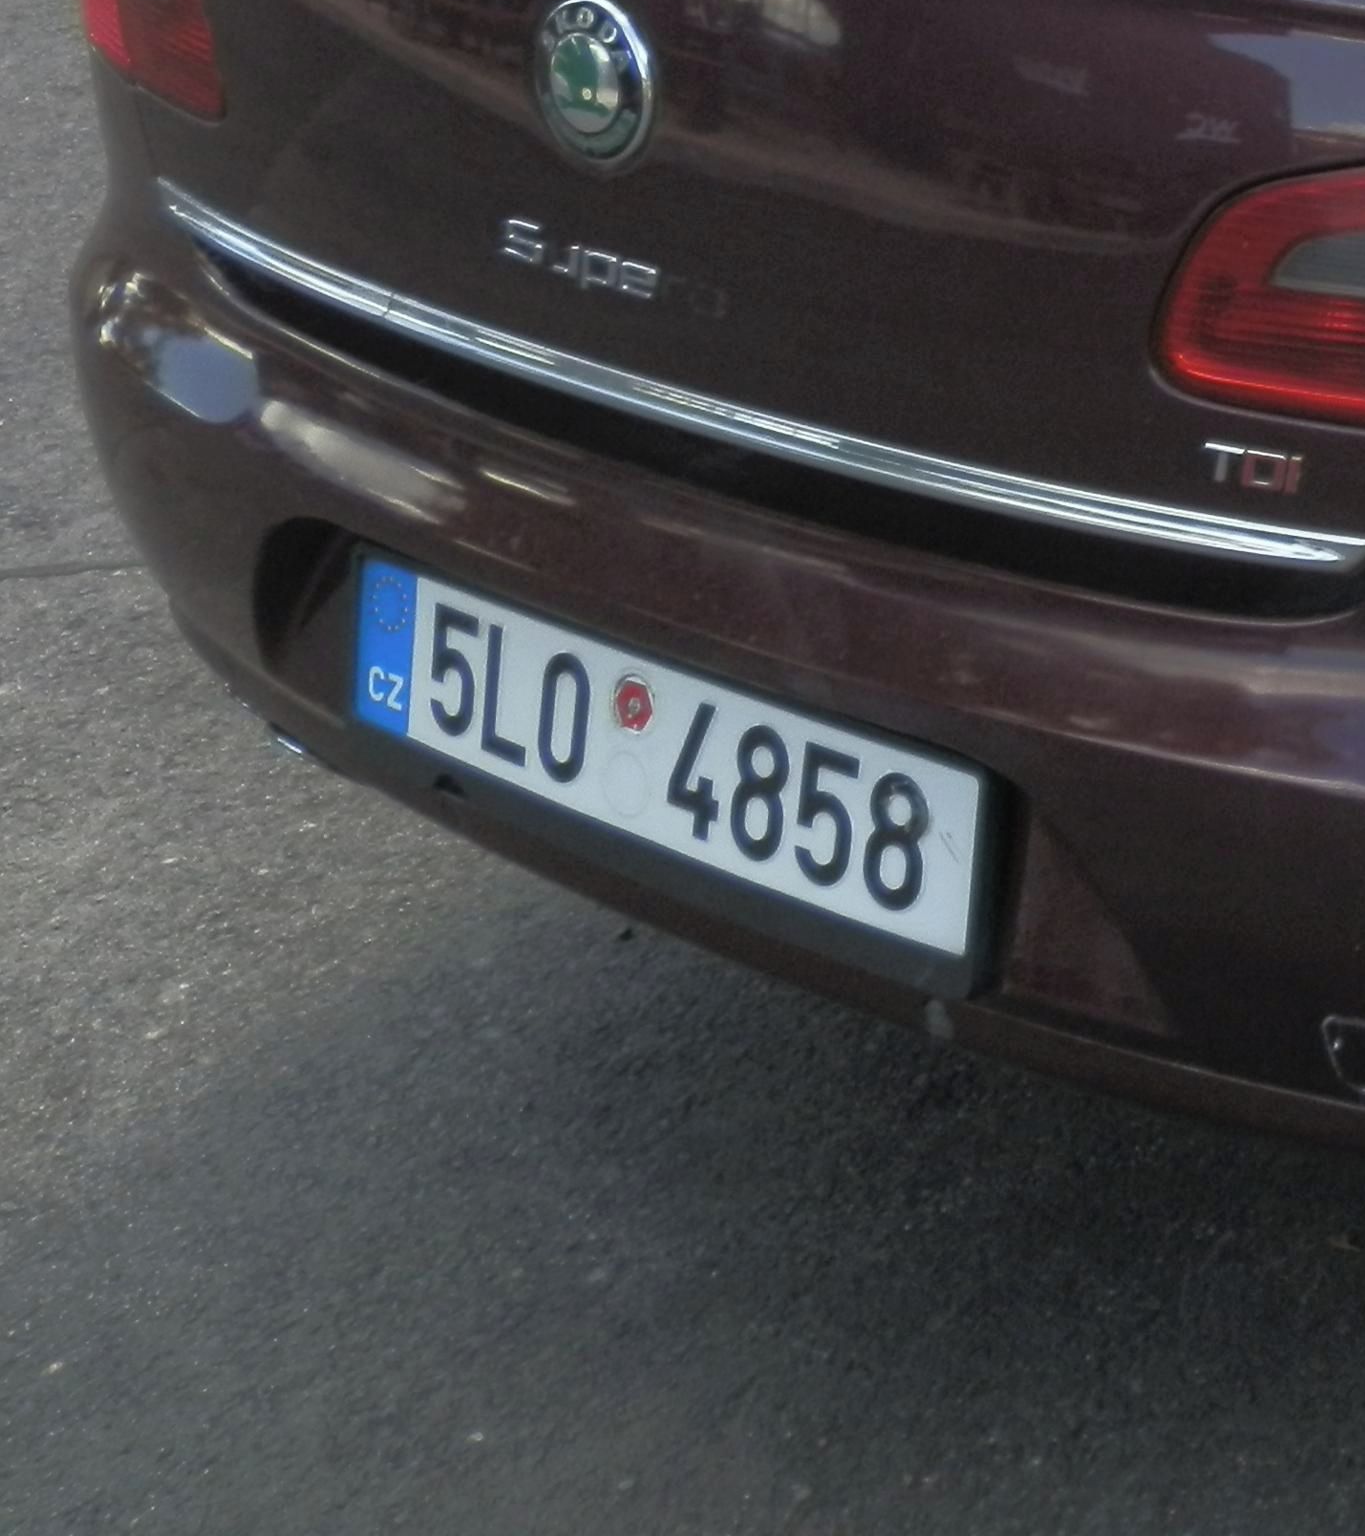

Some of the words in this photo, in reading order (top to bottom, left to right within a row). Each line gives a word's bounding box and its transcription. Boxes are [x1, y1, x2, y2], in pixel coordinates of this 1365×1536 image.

[368, 666, 404, 712] CZ
[430, 602, 590, 784] 5L0
[667, 702, 930, 911] 4858
